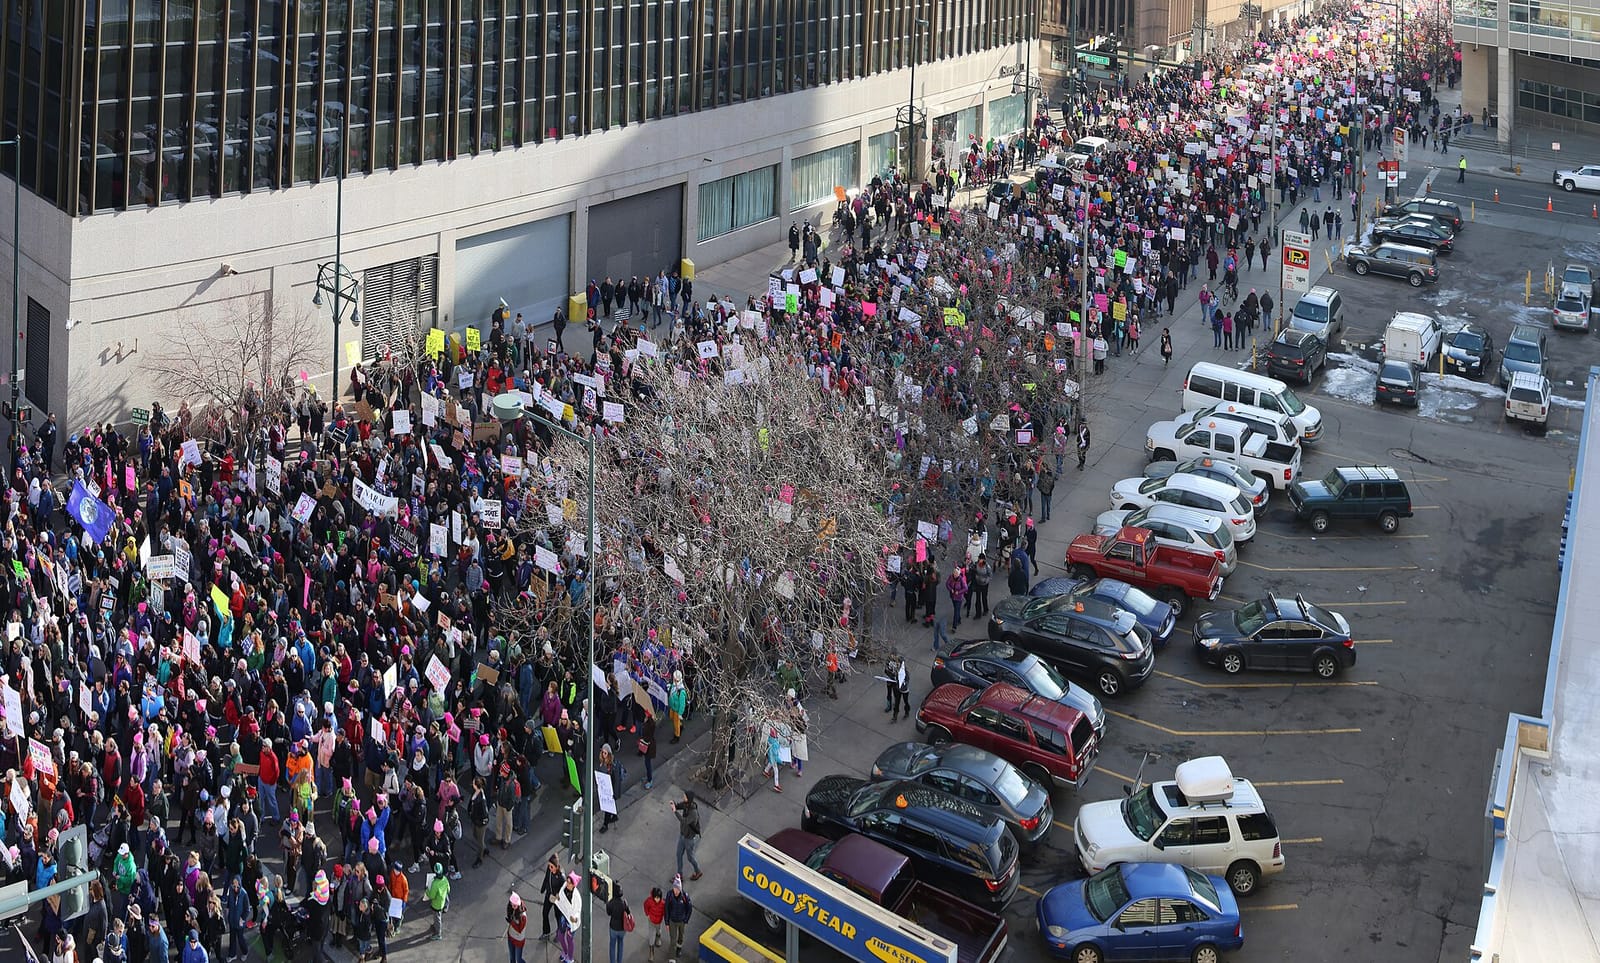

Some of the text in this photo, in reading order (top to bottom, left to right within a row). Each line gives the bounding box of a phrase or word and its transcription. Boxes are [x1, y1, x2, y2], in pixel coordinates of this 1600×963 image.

[484, 510, 499, 518] STATE
[395, 523, 419, 546] FEMINISM
[743, 866, 857, 939] GOODYEAR
[872, 939, 890, 953] TIRE
